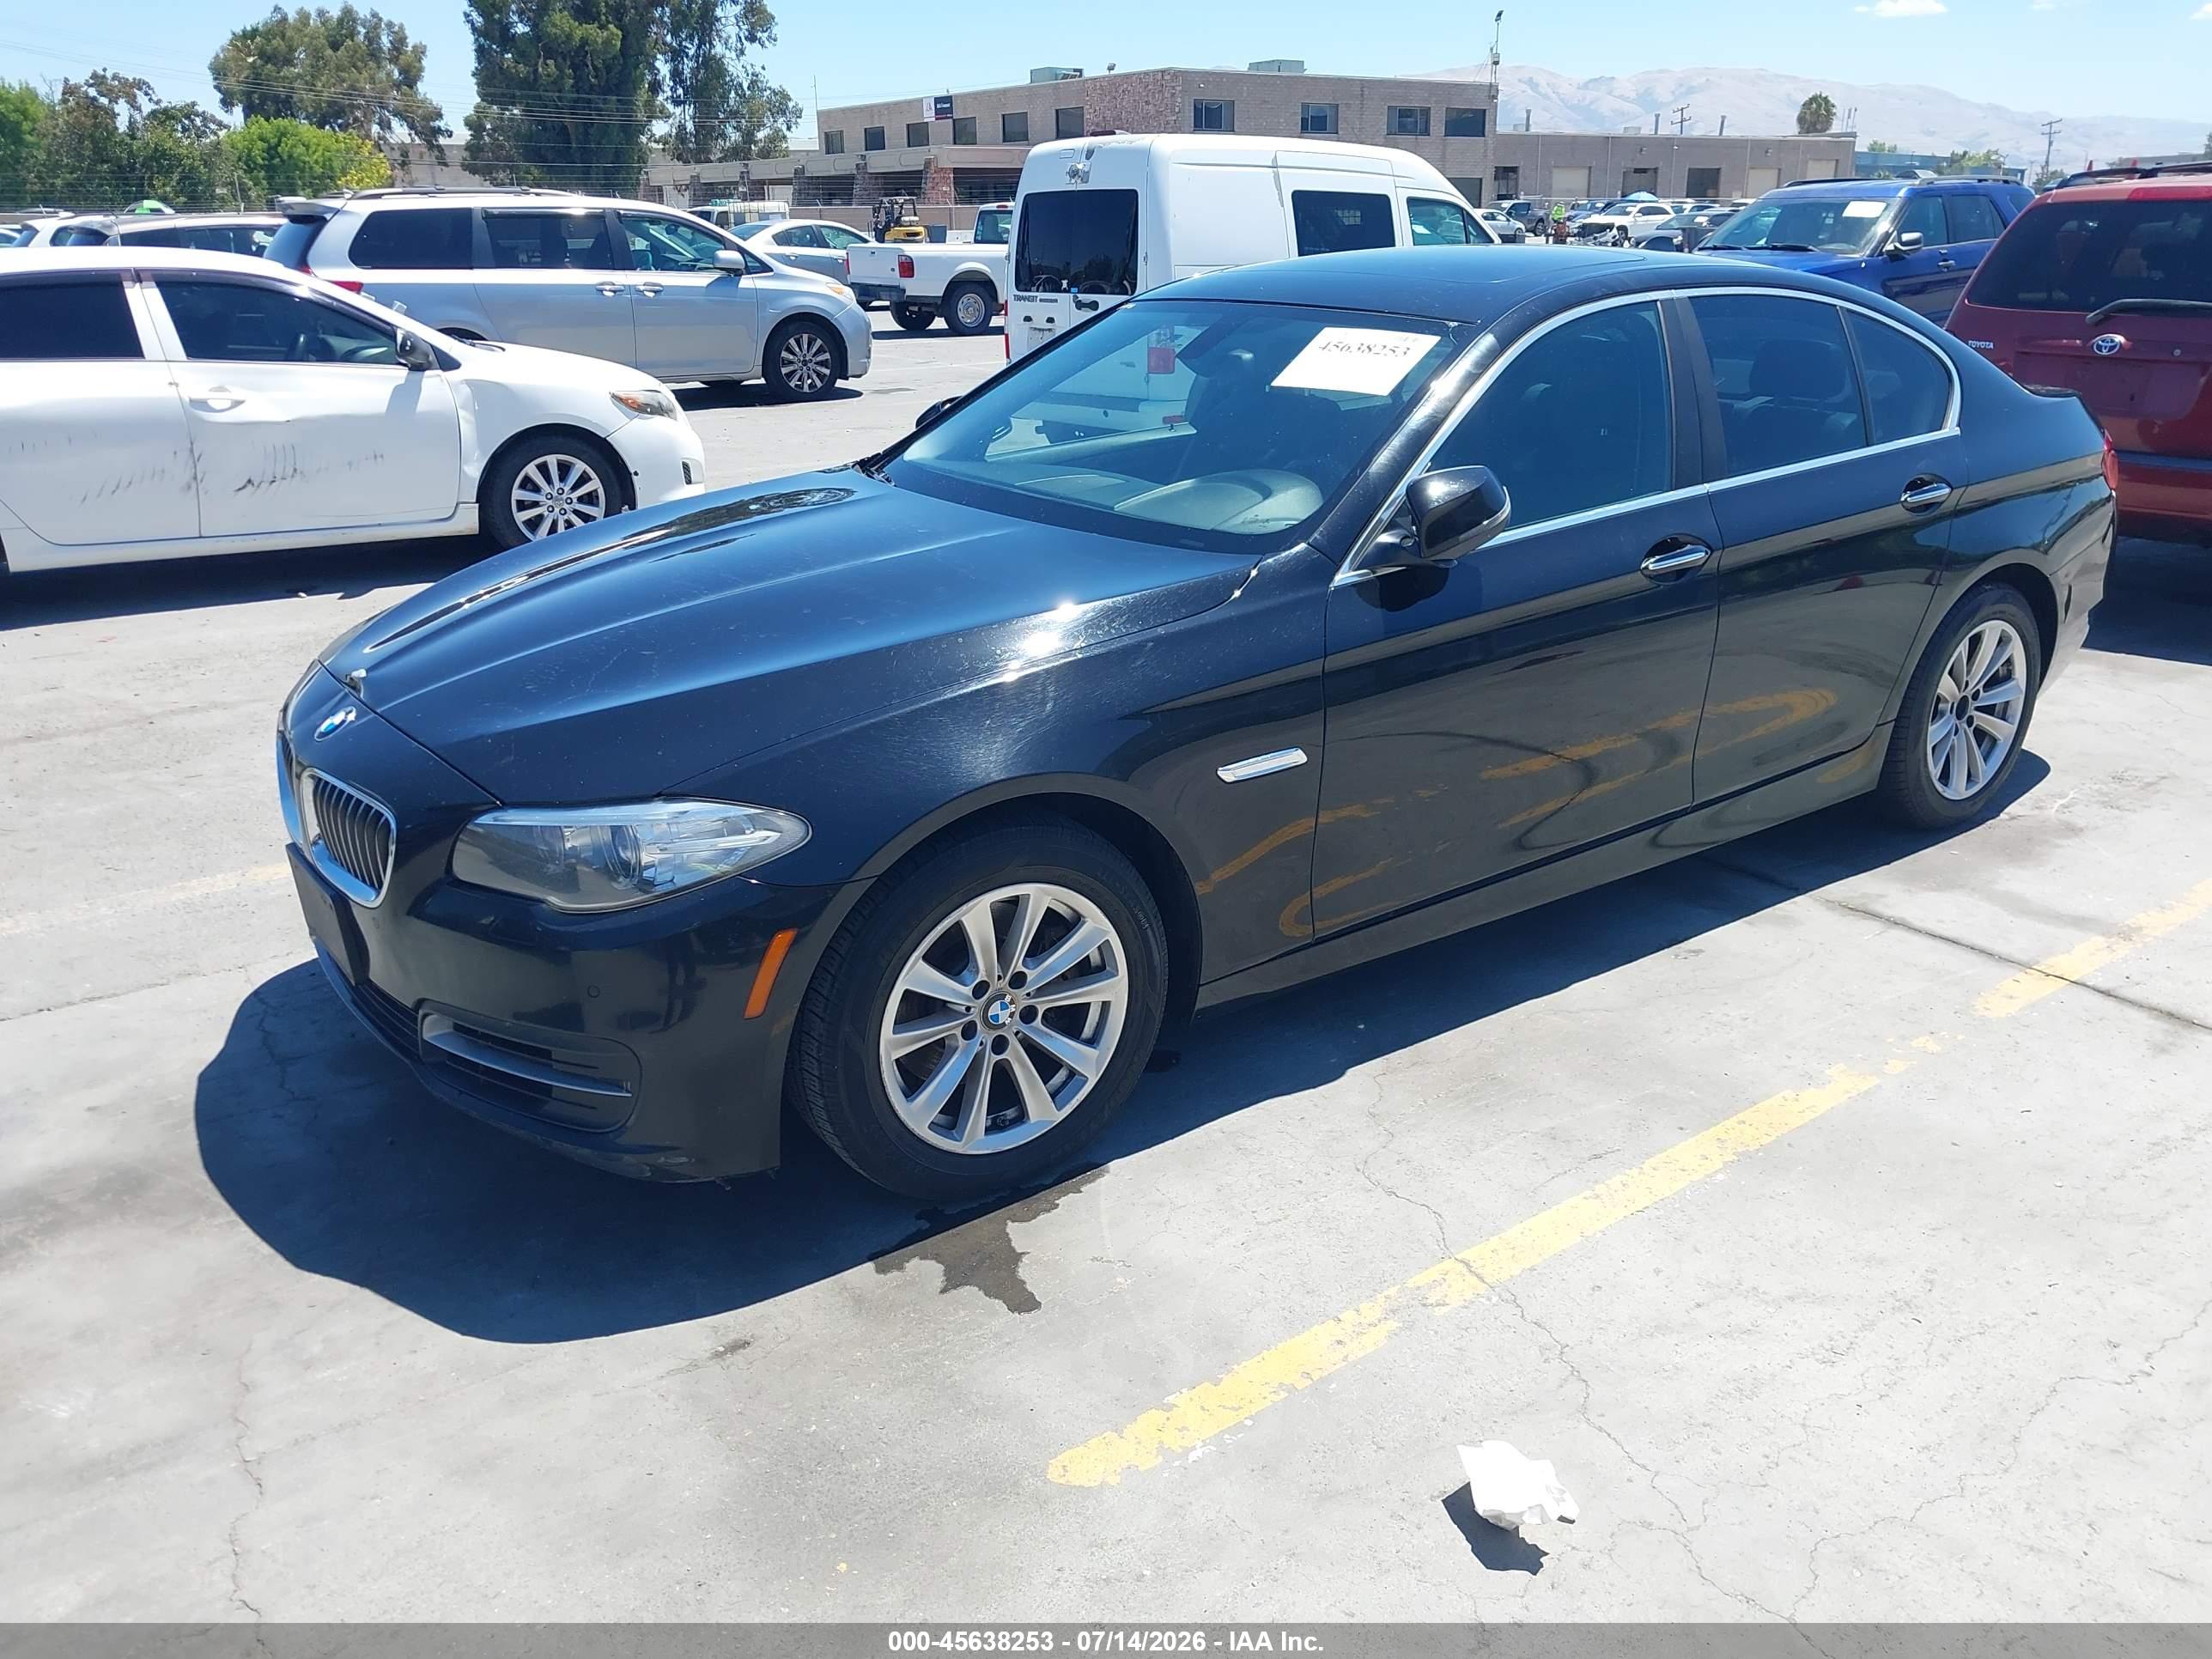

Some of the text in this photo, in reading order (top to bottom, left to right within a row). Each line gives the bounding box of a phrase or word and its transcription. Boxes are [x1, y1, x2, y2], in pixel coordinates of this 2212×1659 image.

[1013, 295, 1038, 303] TRANSIT
[1318, 341, 1411, 357] 45638253
[1968, 340, 1994, 349] TOYOTA
